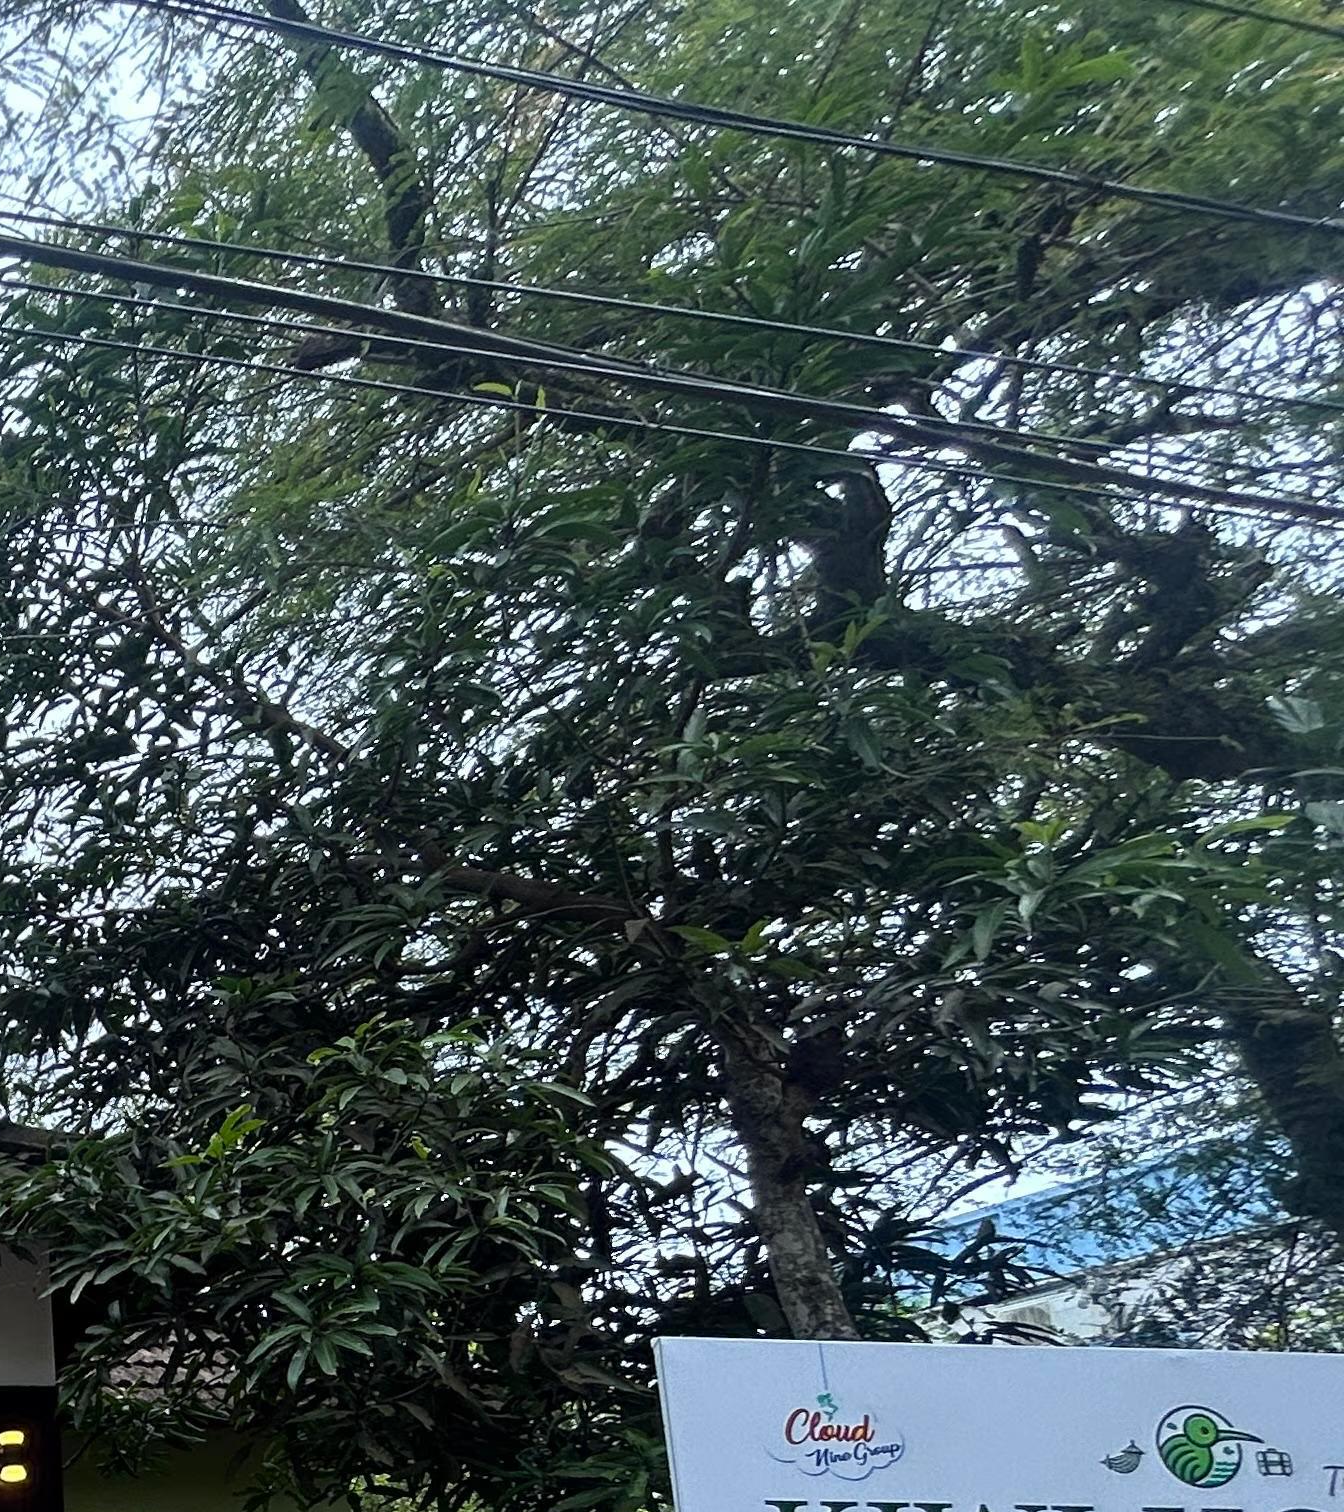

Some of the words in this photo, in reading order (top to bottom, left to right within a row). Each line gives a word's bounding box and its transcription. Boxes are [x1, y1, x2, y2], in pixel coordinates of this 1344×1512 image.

[785, 1408, 875, 1445] Cloud
[805, 1448, 852, 1467] Nine
[853, 1442, 901, 1466] Group
